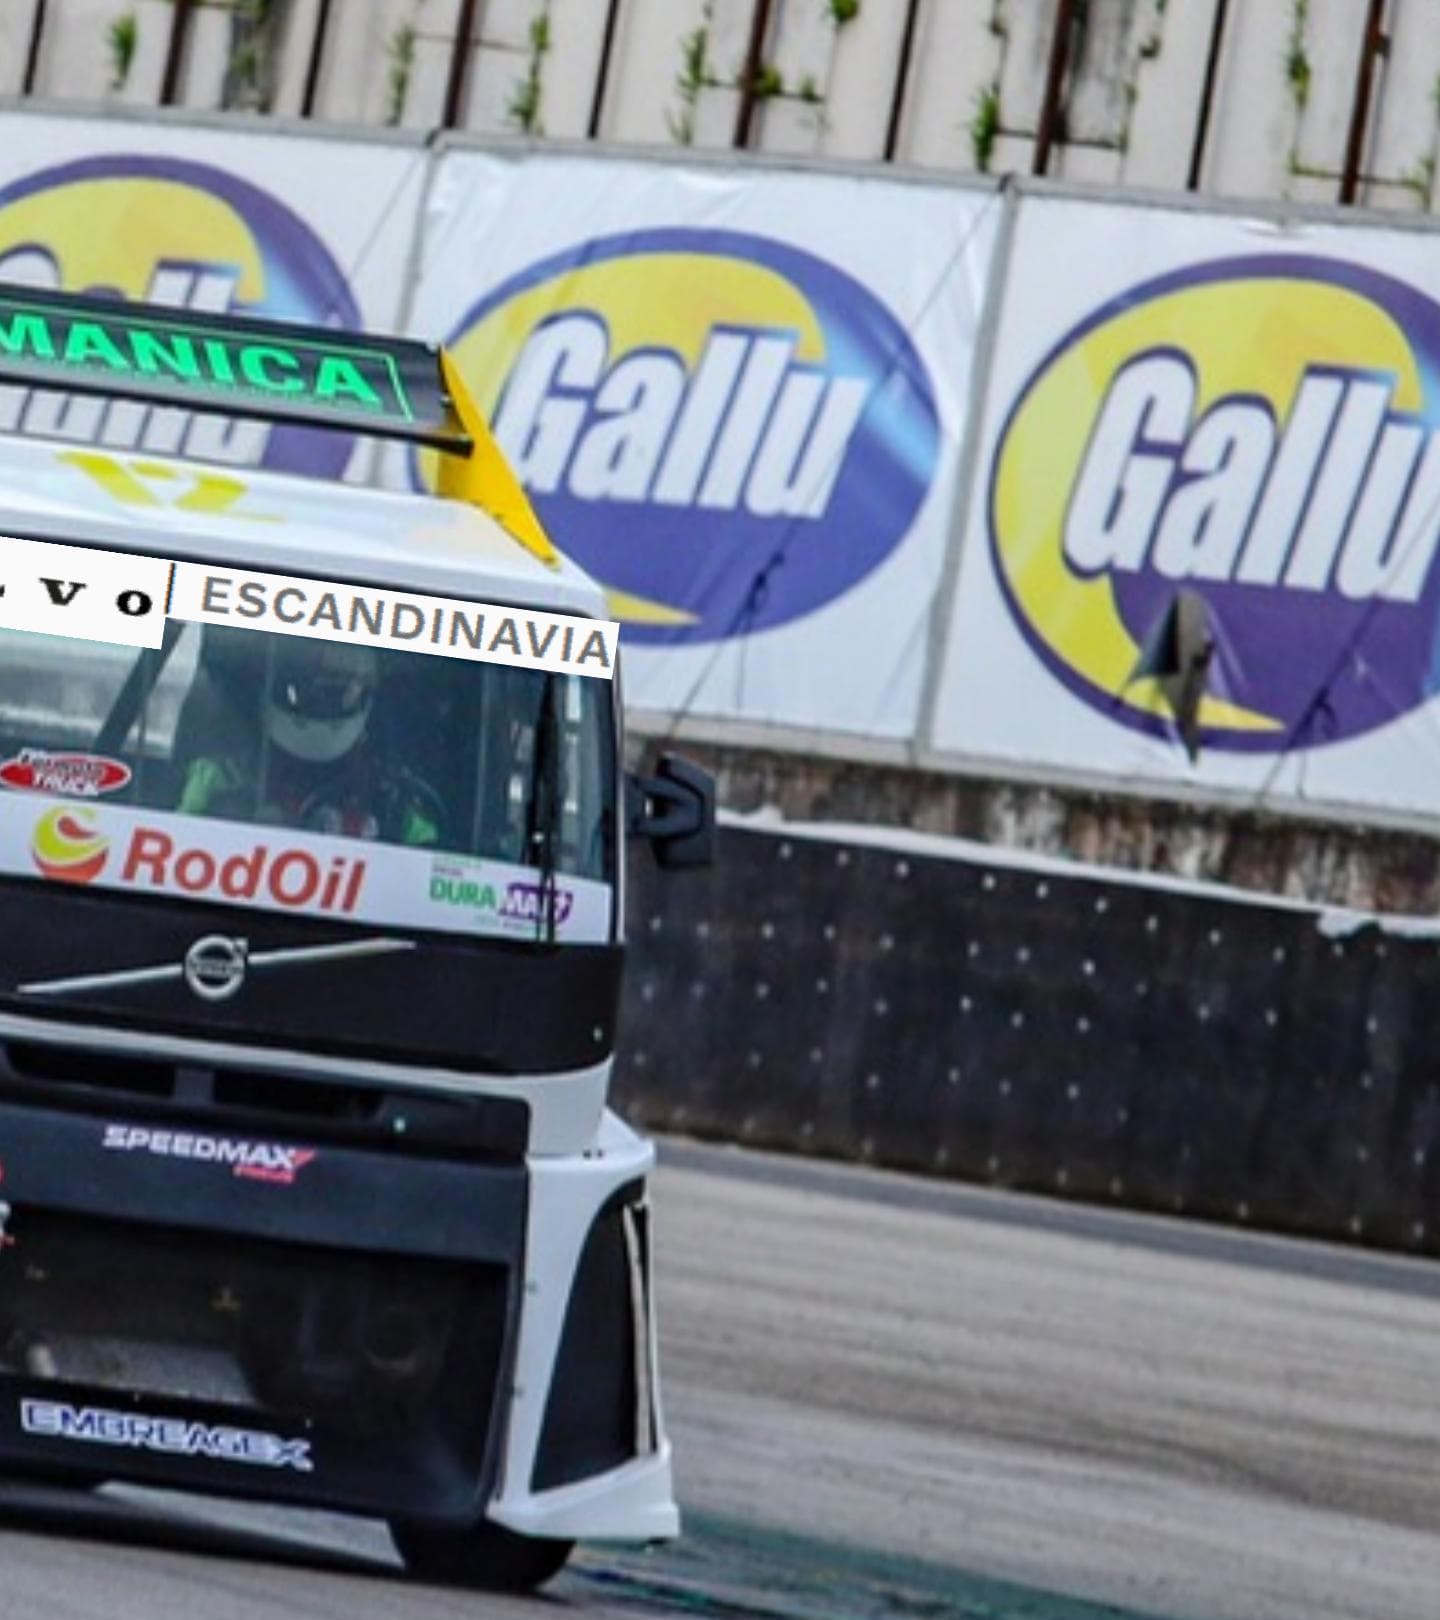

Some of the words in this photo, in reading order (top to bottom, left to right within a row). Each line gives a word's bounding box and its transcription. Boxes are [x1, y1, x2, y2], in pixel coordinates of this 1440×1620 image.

[491, 302, 870, 520] Gallu
[1062, 347, 1440, 602] Gallu
[122, 825, 367, 913] RodOil
[102, 1123, 297, 1171] SPEEDMAX
